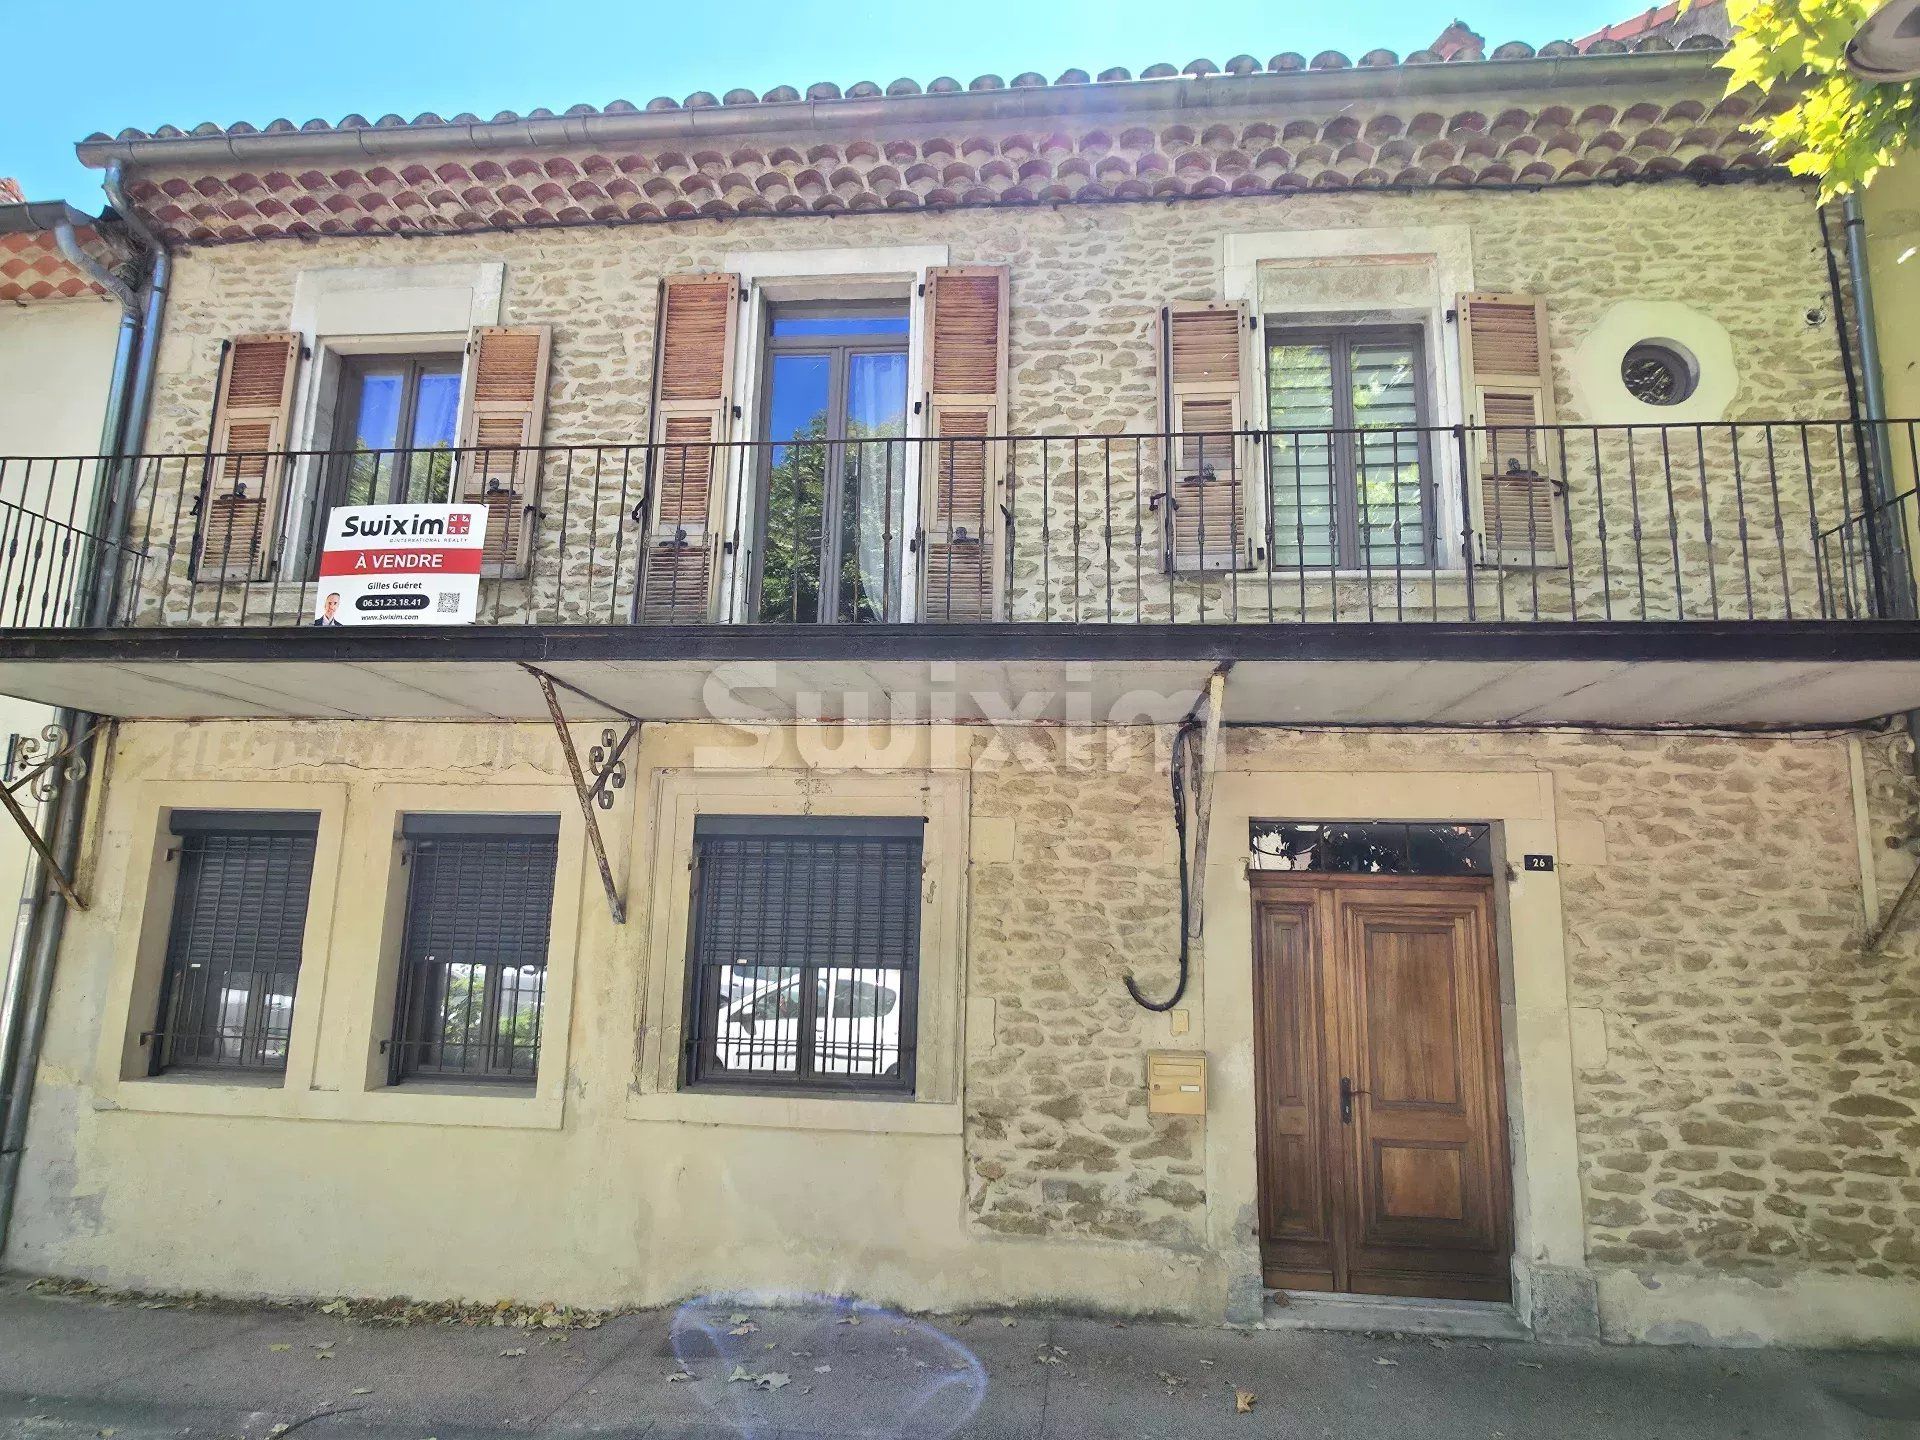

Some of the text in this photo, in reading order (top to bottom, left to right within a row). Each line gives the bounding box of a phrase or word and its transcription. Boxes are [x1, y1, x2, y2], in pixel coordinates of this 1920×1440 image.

[341, 514, 444, 537] Swixim
[354, 553, 443, 569] À VENDRE
[367, 581, 422, 590] Gilles Guéret
[362, 598, 421, 607] 06.51.23.18.41
[361, 613, 419, 621] www.Swixim.com
[1533, 858, 1546, 867] 26
